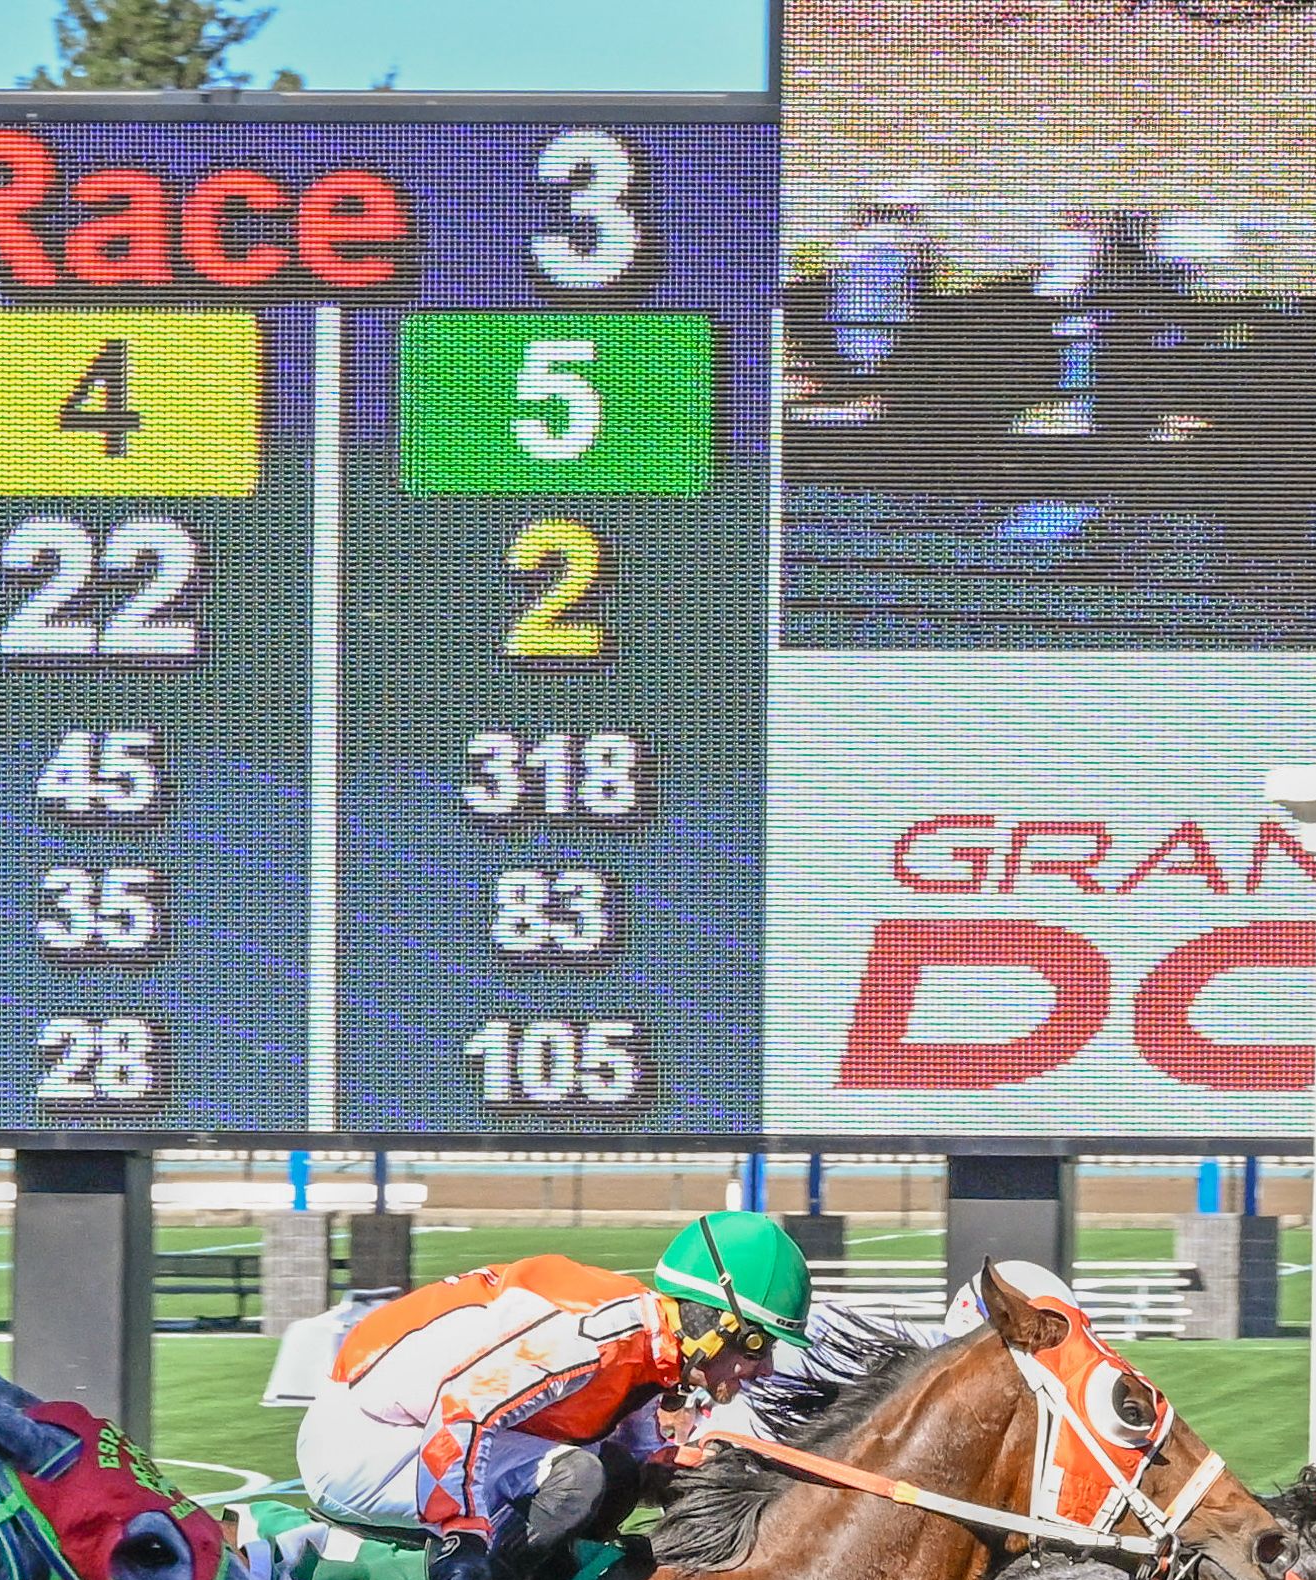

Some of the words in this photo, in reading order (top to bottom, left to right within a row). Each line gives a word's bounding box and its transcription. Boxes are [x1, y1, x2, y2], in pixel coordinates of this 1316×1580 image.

[529, 129, 645, 289] 3
[59, 338, 142, 459] 4
[508, 339, 603, 463] 5
[506, 517, 603, 659] 2
[36, 731, 160, 813] 45
[463, 733, 638, 816] 318
[36, 867, 160, 950] 35
[492, 870, 607, 953] 83
[36, 1018, 152, 1101] 28
[463, 1020, 642, 1103] 105
